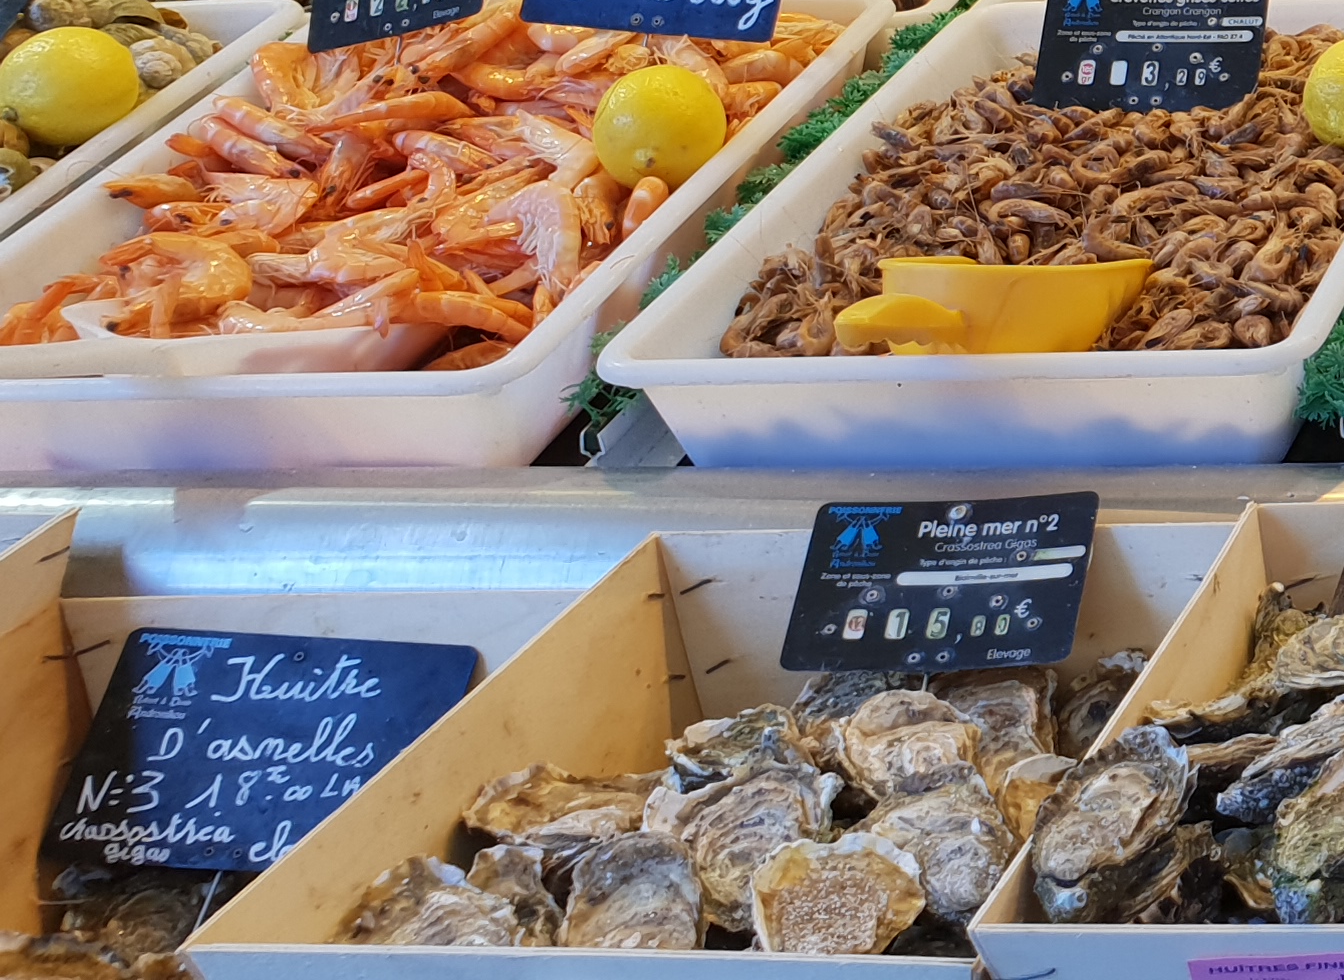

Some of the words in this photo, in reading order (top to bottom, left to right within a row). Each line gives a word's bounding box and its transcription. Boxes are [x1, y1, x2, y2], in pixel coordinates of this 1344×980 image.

[918, 520, 977, 538] Pleine
[982, 521, 1021, 536] mer
[1024, 514, 1060, 534] n°2
[935, 540, 1002, 552] Crassostrea
[1006, 538, 1037, 549] Gigas
